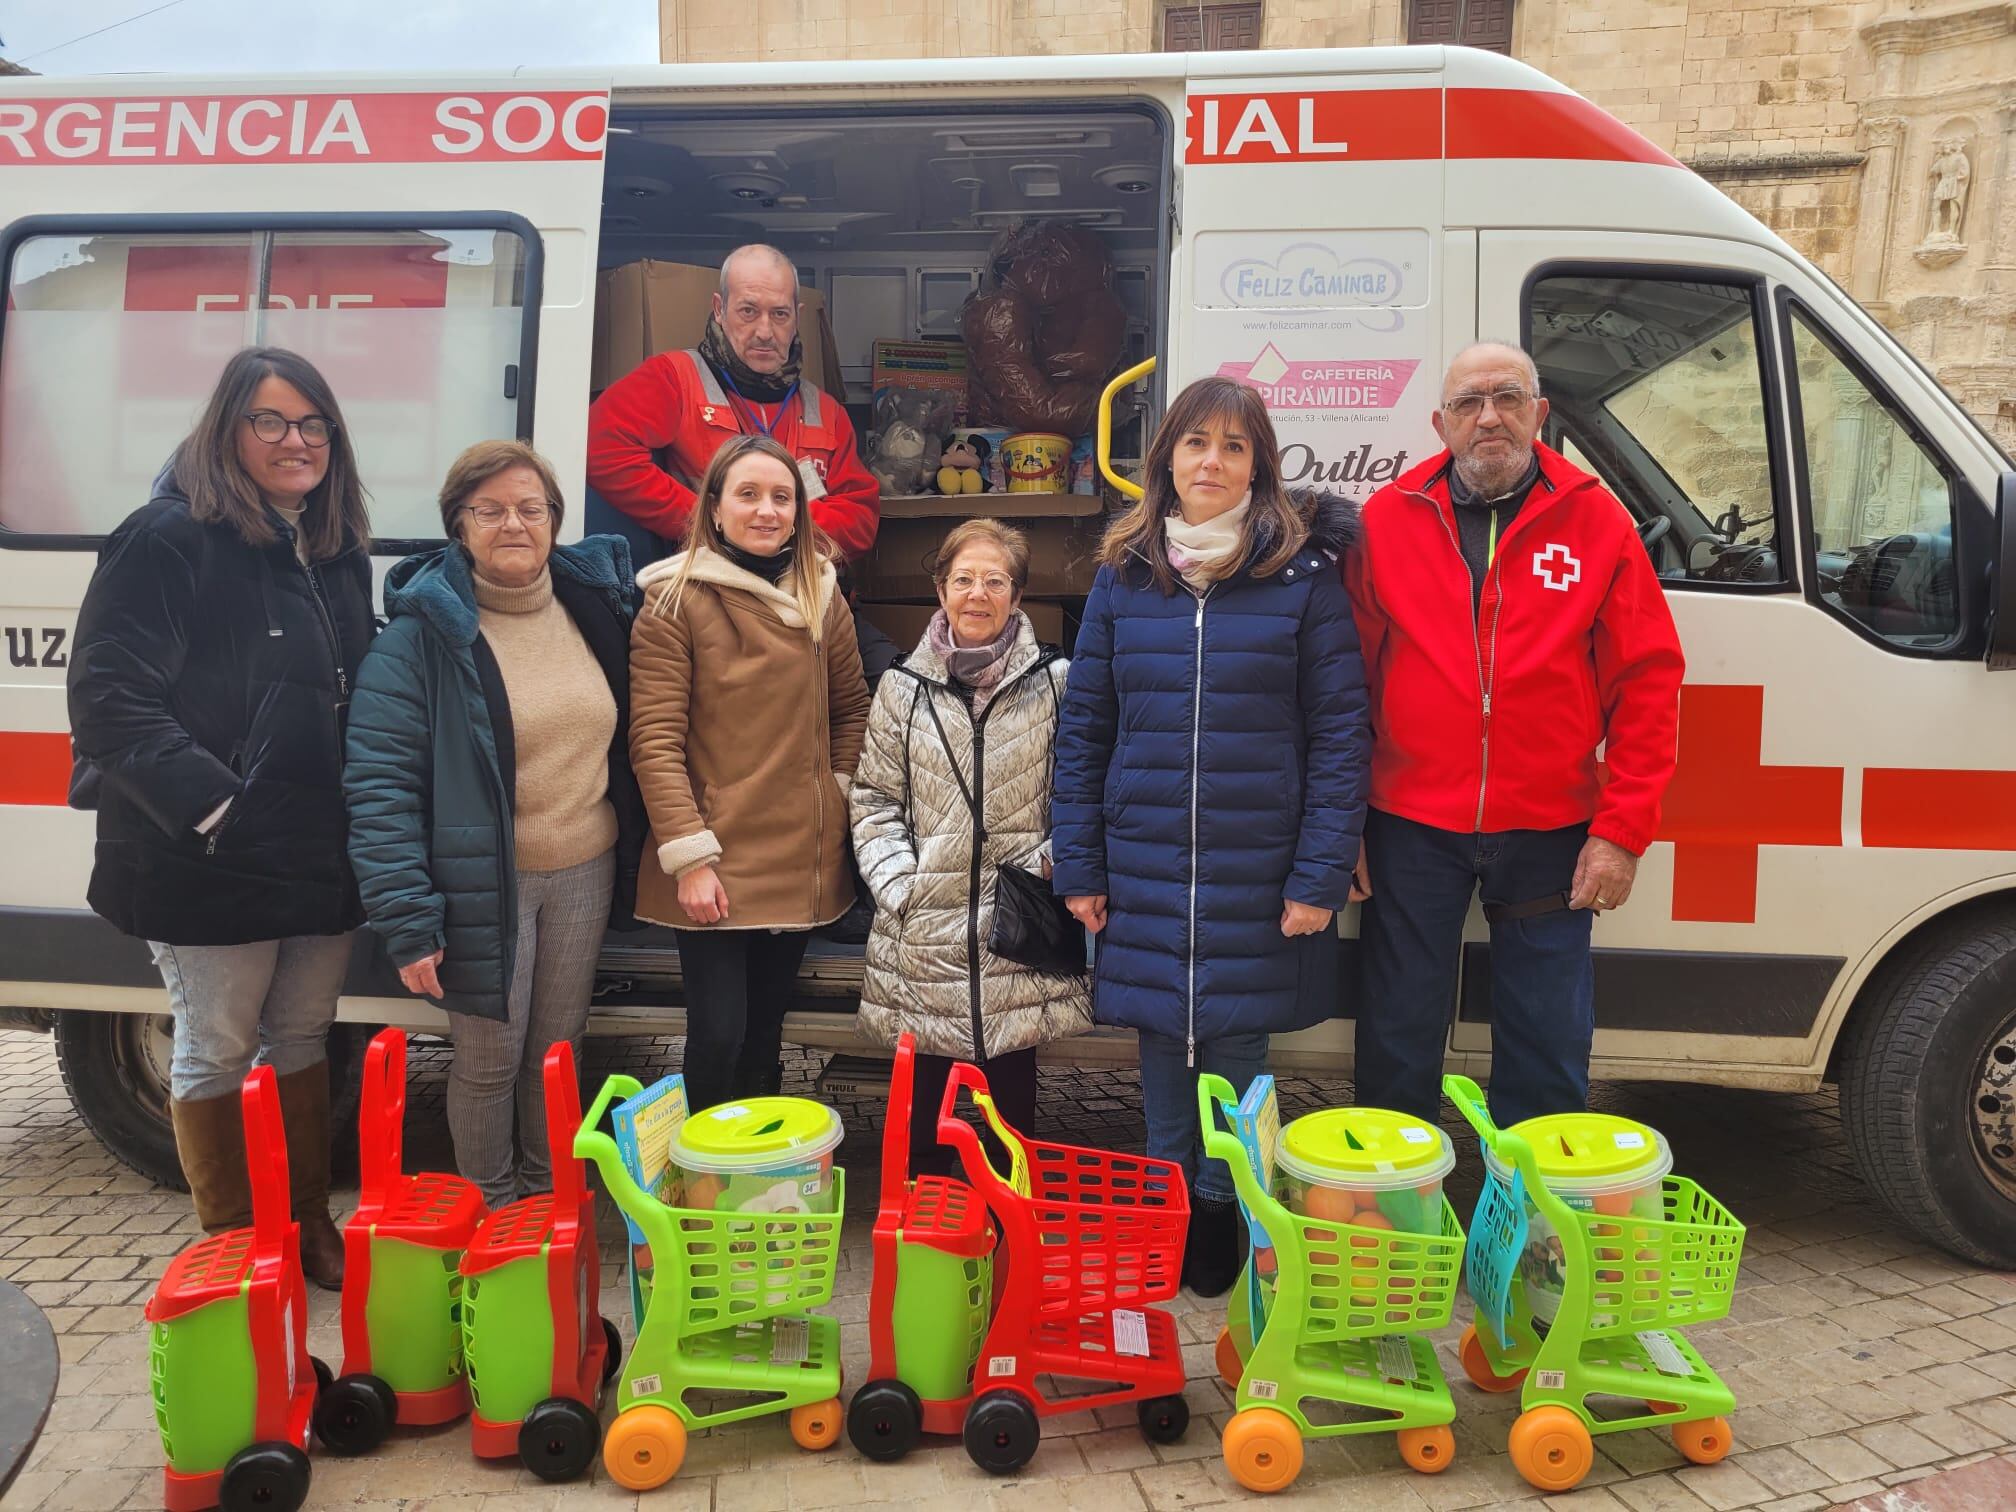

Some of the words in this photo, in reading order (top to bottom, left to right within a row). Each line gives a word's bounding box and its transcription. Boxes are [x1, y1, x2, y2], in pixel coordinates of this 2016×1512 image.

[1184, 98, 1348, 156] IAL
[1242, 320, 1352, 331] www.felizcaminar.com
[1301, 366, 1394, 381] CAFETERÍA
[1257, 385, 1378, 406] PIRÁMIDE
[1305, 414, 1315, 423] 53
[1321, 414, 1349, 423] Villena
[1350, 413, 1390, 424] (Alicante)
[1279, 444, 1408, 483] Outlet
[0, 627, 67, 668] uz
[825, 1083, 857, 1093] THULE
